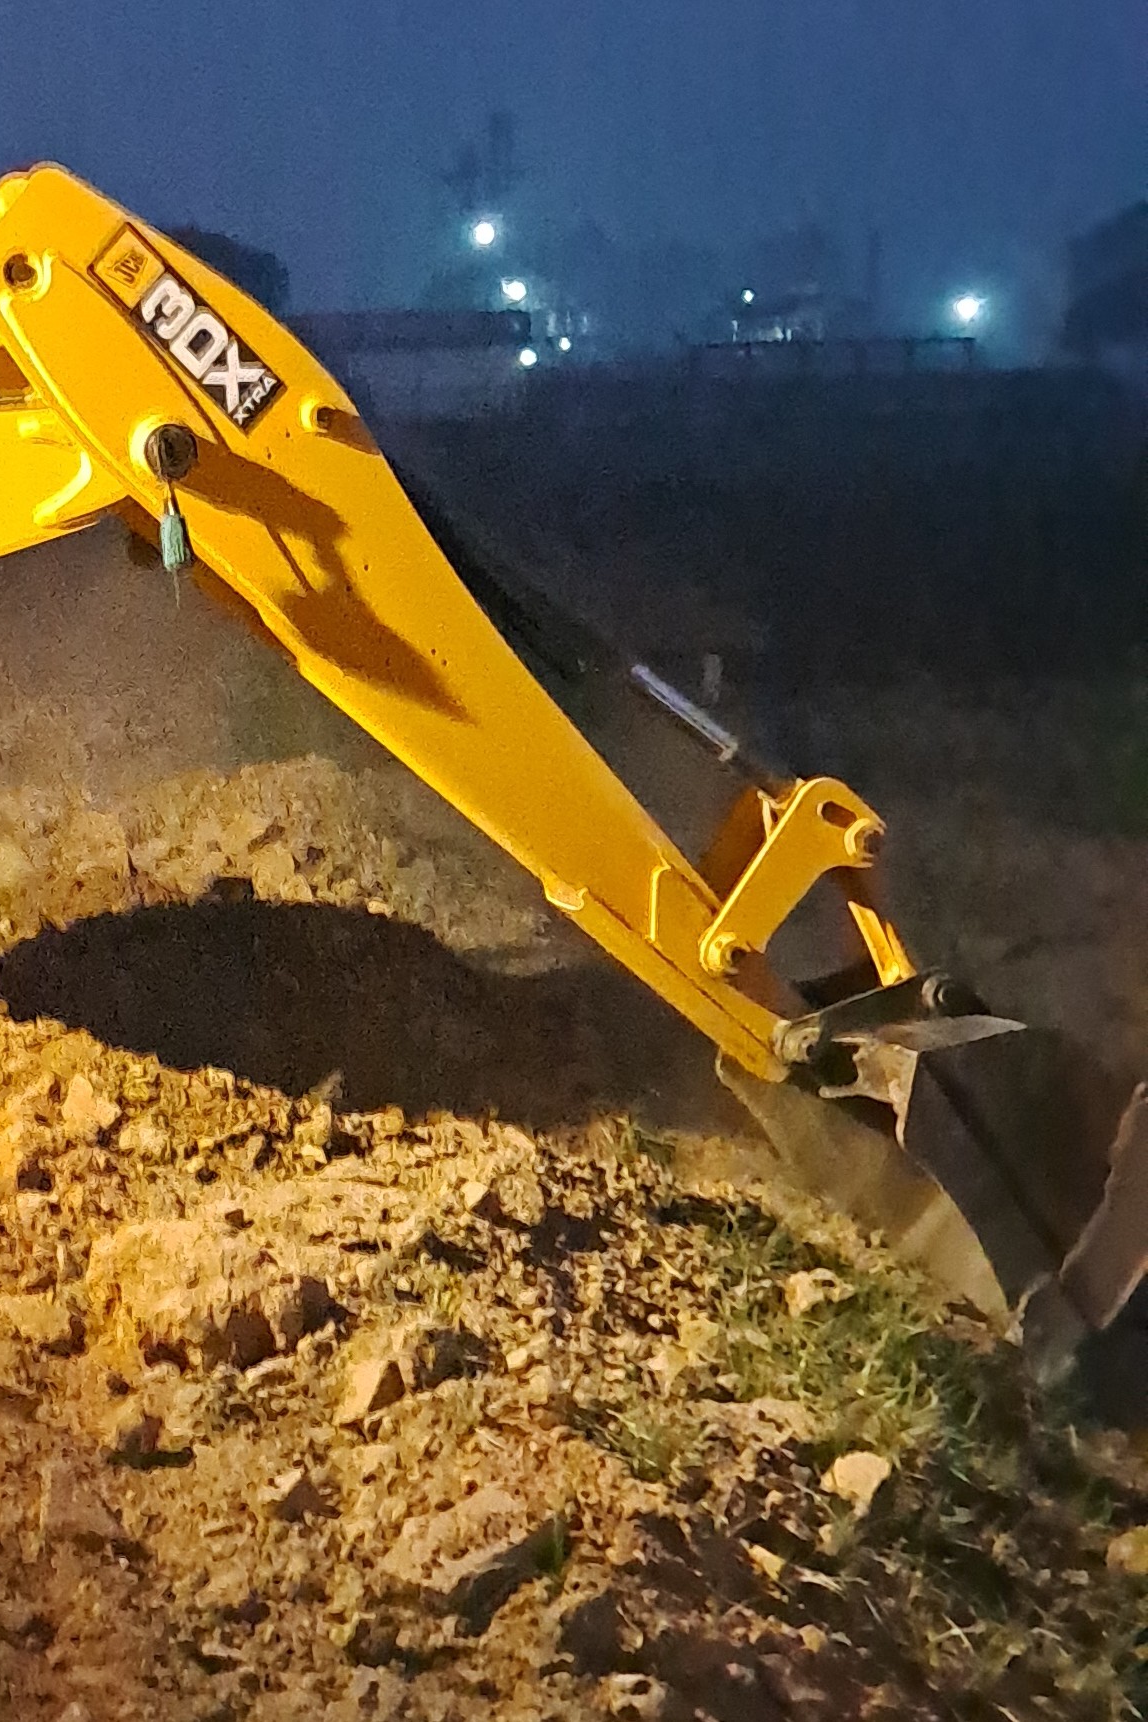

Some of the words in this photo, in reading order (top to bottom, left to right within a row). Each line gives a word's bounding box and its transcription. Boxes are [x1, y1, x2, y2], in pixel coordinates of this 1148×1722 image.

[114, 250, 147, 284] JCB
[141, 277, 265, 414] 3DX
[233, 375, 278, 426] XTRA
